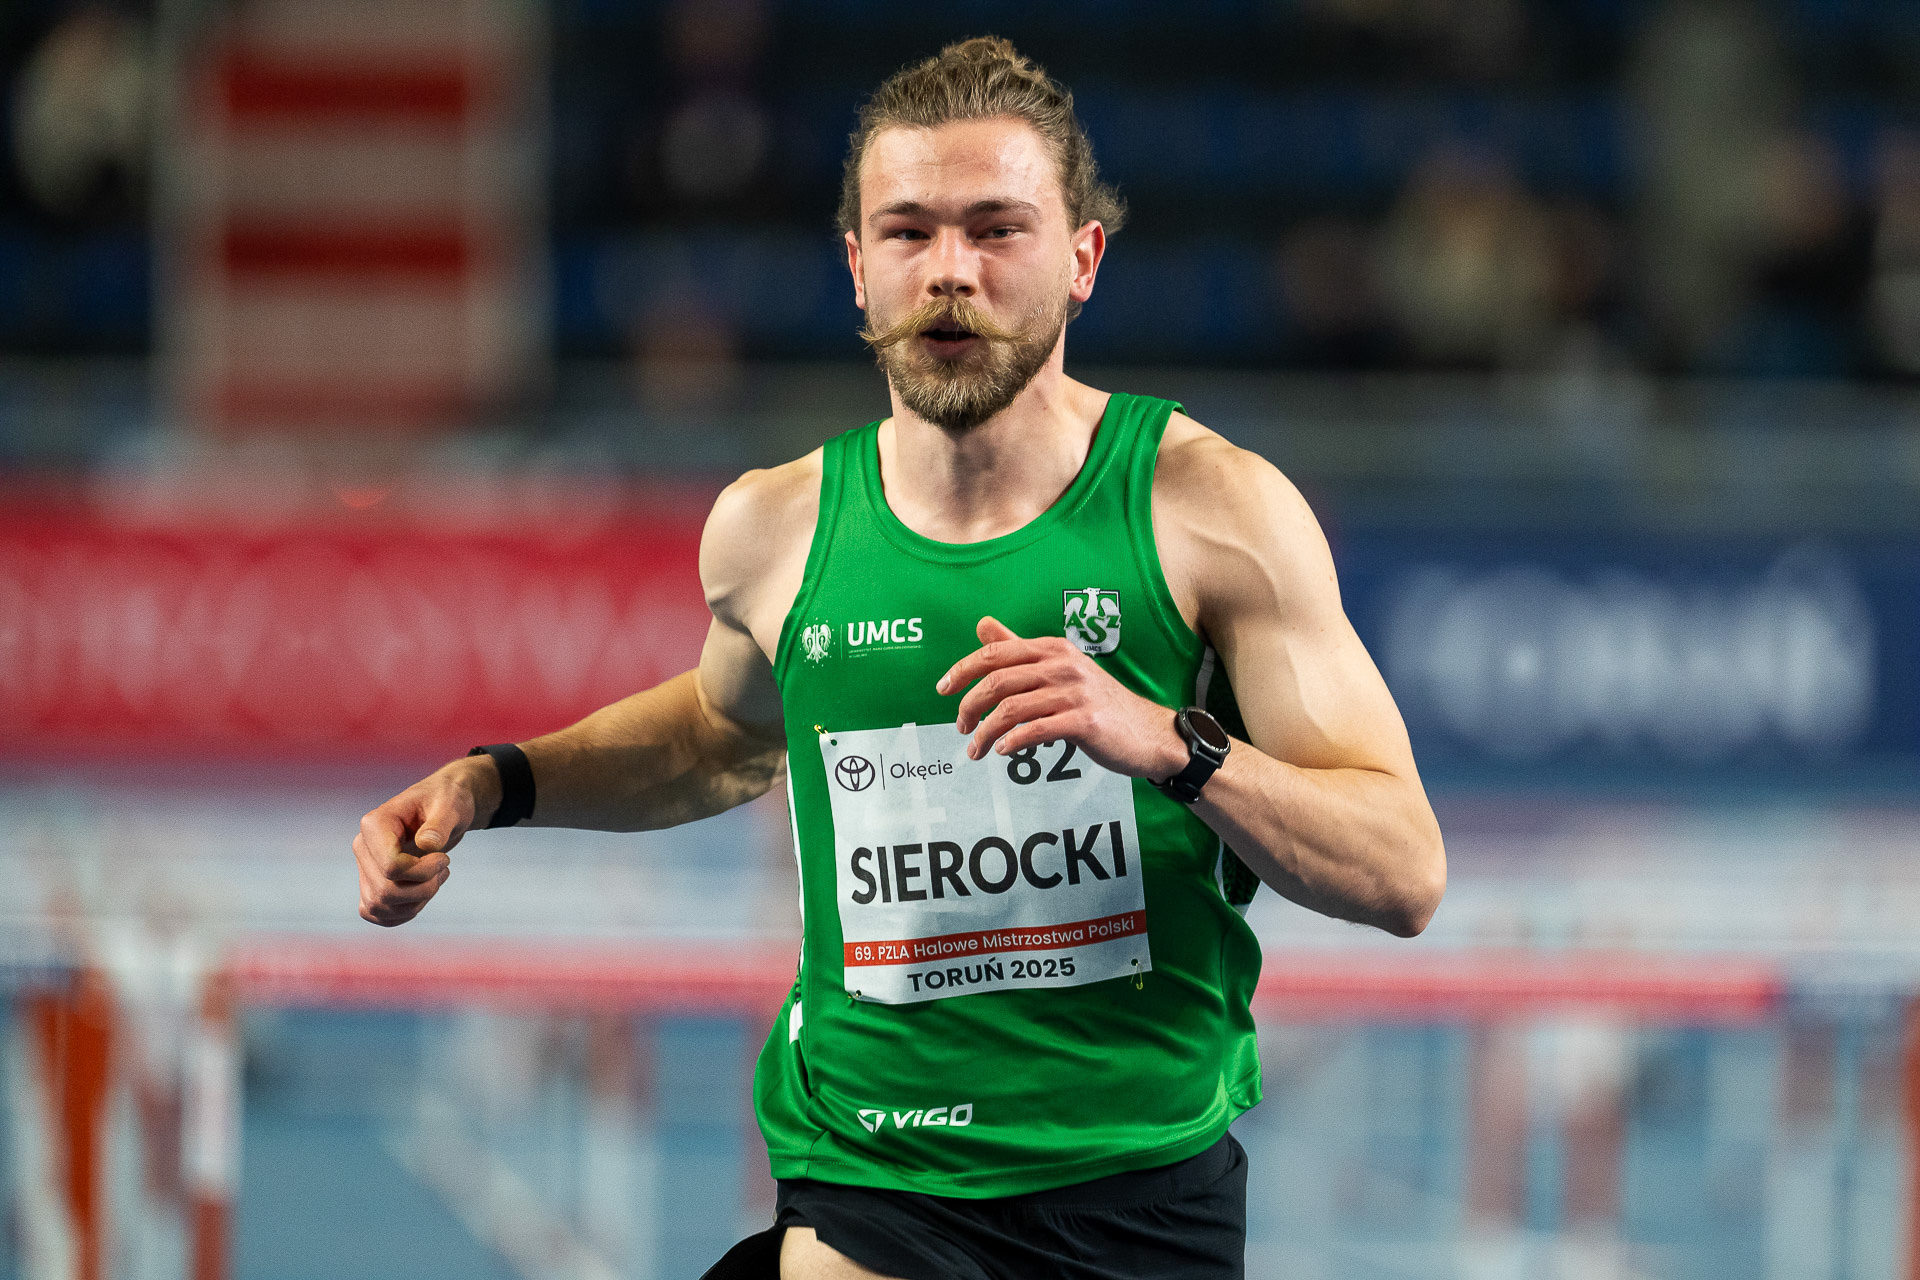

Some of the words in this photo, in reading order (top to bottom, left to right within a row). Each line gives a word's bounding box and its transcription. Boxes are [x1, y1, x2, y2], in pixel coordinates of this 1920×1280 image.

[847, 617, 923, 647] UMCS
[890, 759, 953, 780] Okęcie
[1006, 739, 1082, 785] 82
[851, 820, 1128, 905] SIEROCKI
[855, 946, 875, 961] 69.
[878, 945, 910, 960] PZLA
[914, 939, 979, 958] Halowe
[982, 929, 1084, 949] Mistrzostwa
[1088, 916, 1135, 939] Polski
[907, 956, 1005, 993] TORUŃ
[1010, 957, 1076, 979] 2025
